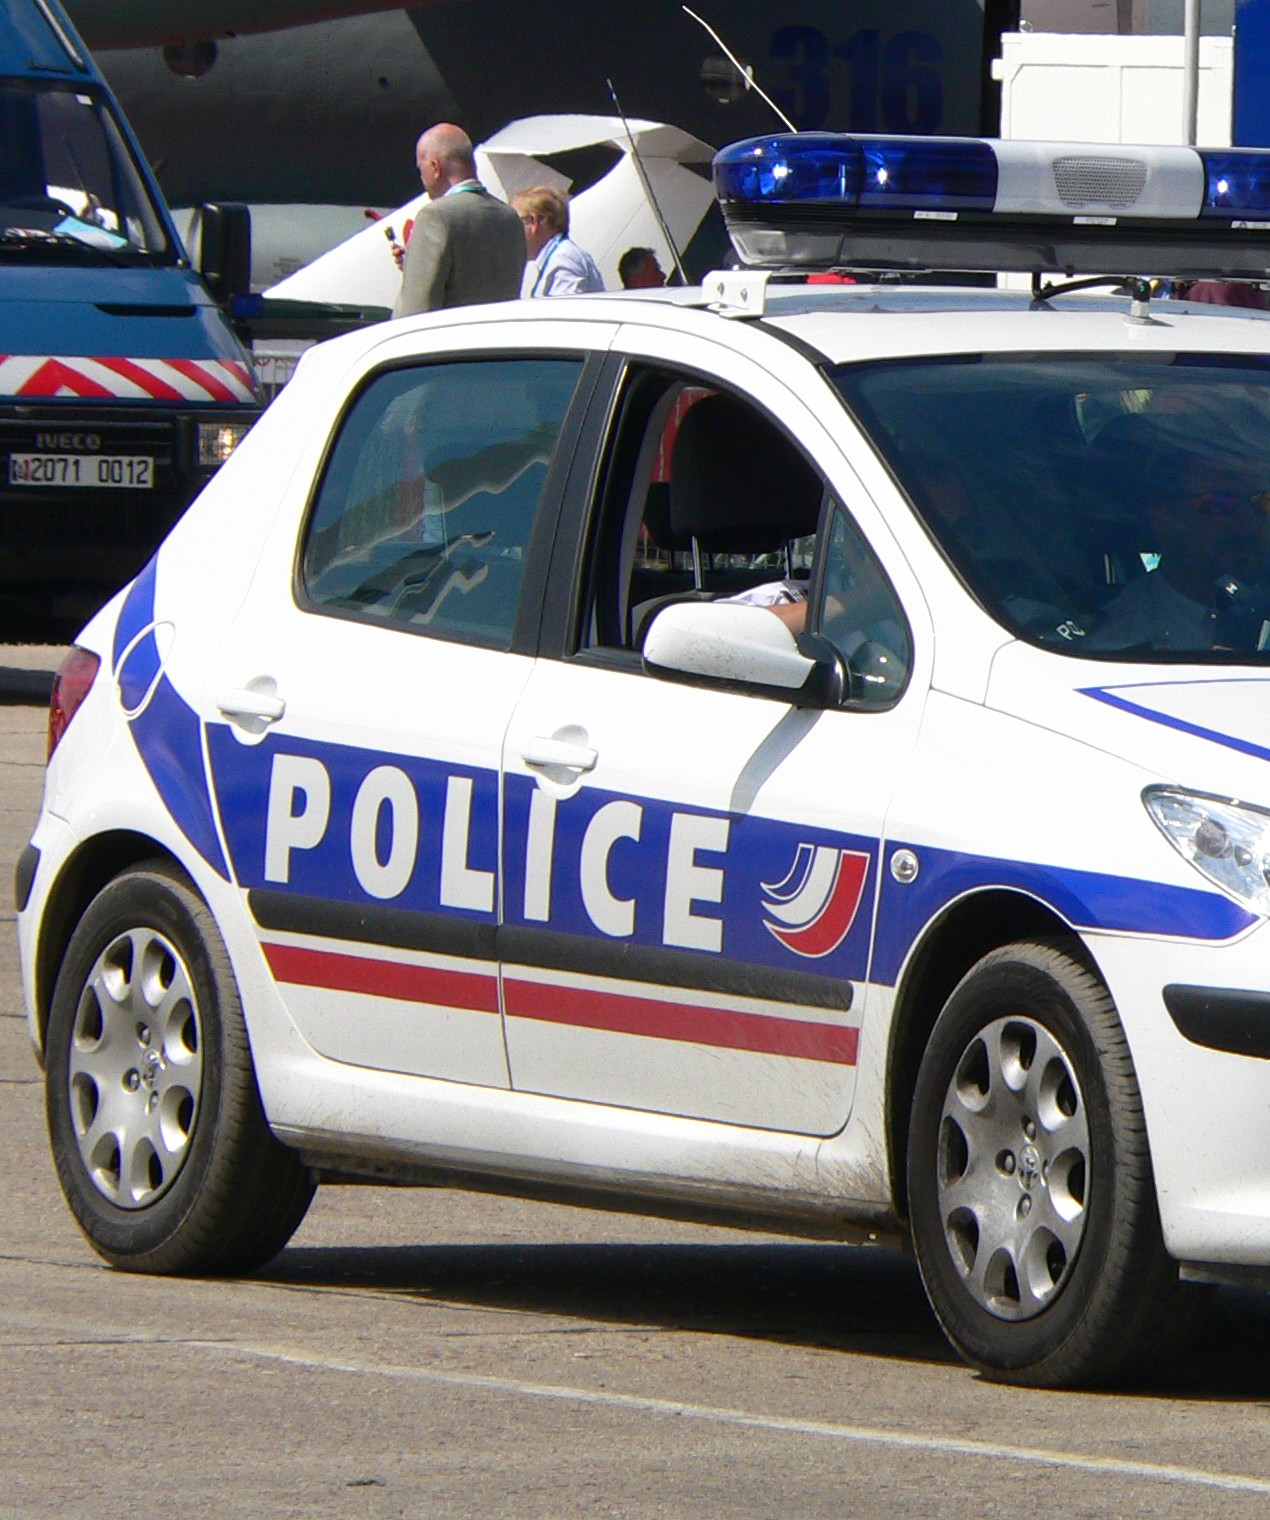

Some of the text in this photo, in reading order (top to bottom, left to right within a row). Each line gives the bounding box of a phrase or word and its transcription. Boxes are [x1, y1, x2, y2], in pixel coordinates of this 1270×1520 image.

[770, 24, 944, 134] 316
[31, 457, 149, 484] 2071 0012
[36, 432, 101, 449] IVECO
[263, 752, 731, 953] POLICE
